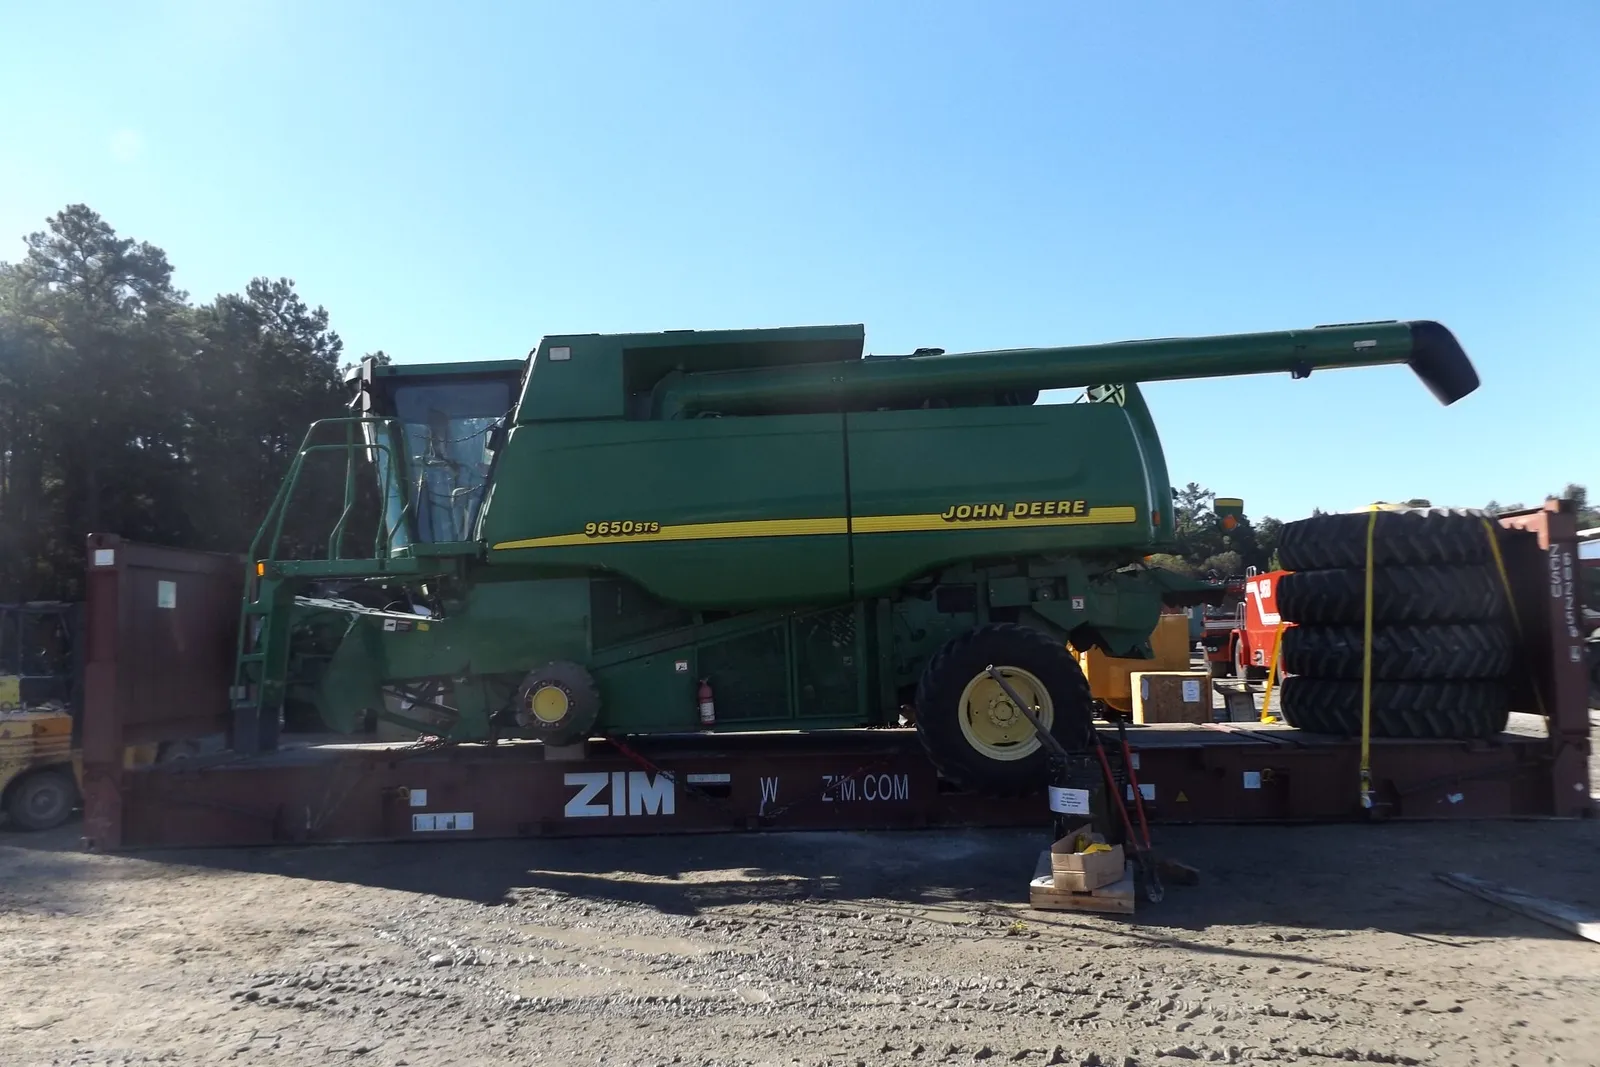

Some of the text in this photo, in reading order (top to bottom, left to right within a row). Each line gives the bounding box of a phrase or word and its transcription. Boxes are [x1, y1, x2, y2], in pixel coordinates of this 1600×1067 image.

[942, 501, 1085, 520] JOHN DEERE
[1549, 543, 1562, 598] ZCSU
[564, 771, 675, 817] ZIM
[760, 776, 779, 803] W
